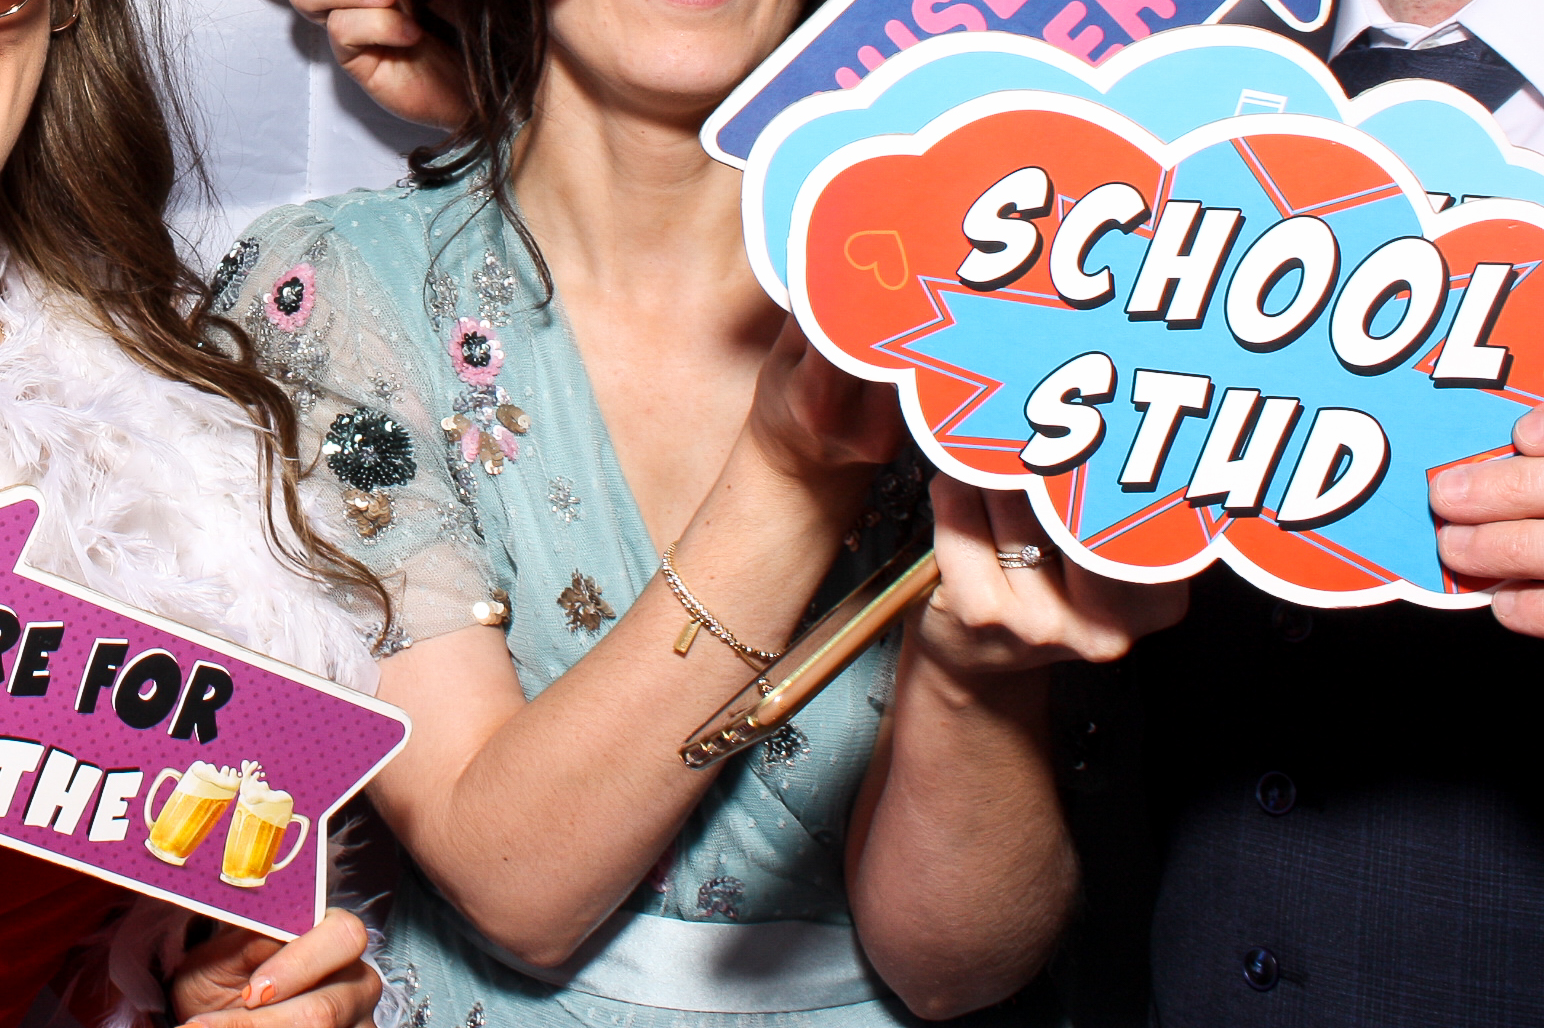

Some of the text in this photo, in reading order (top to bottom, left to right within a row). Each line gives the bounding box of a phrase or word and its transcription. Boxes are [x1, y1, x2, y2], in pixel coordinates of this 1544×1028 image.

[954, 165, 1520, 389] SCHOOL
[1019, 350, 1392, 531] STUD
[74, 636, 234, 744] FOR
